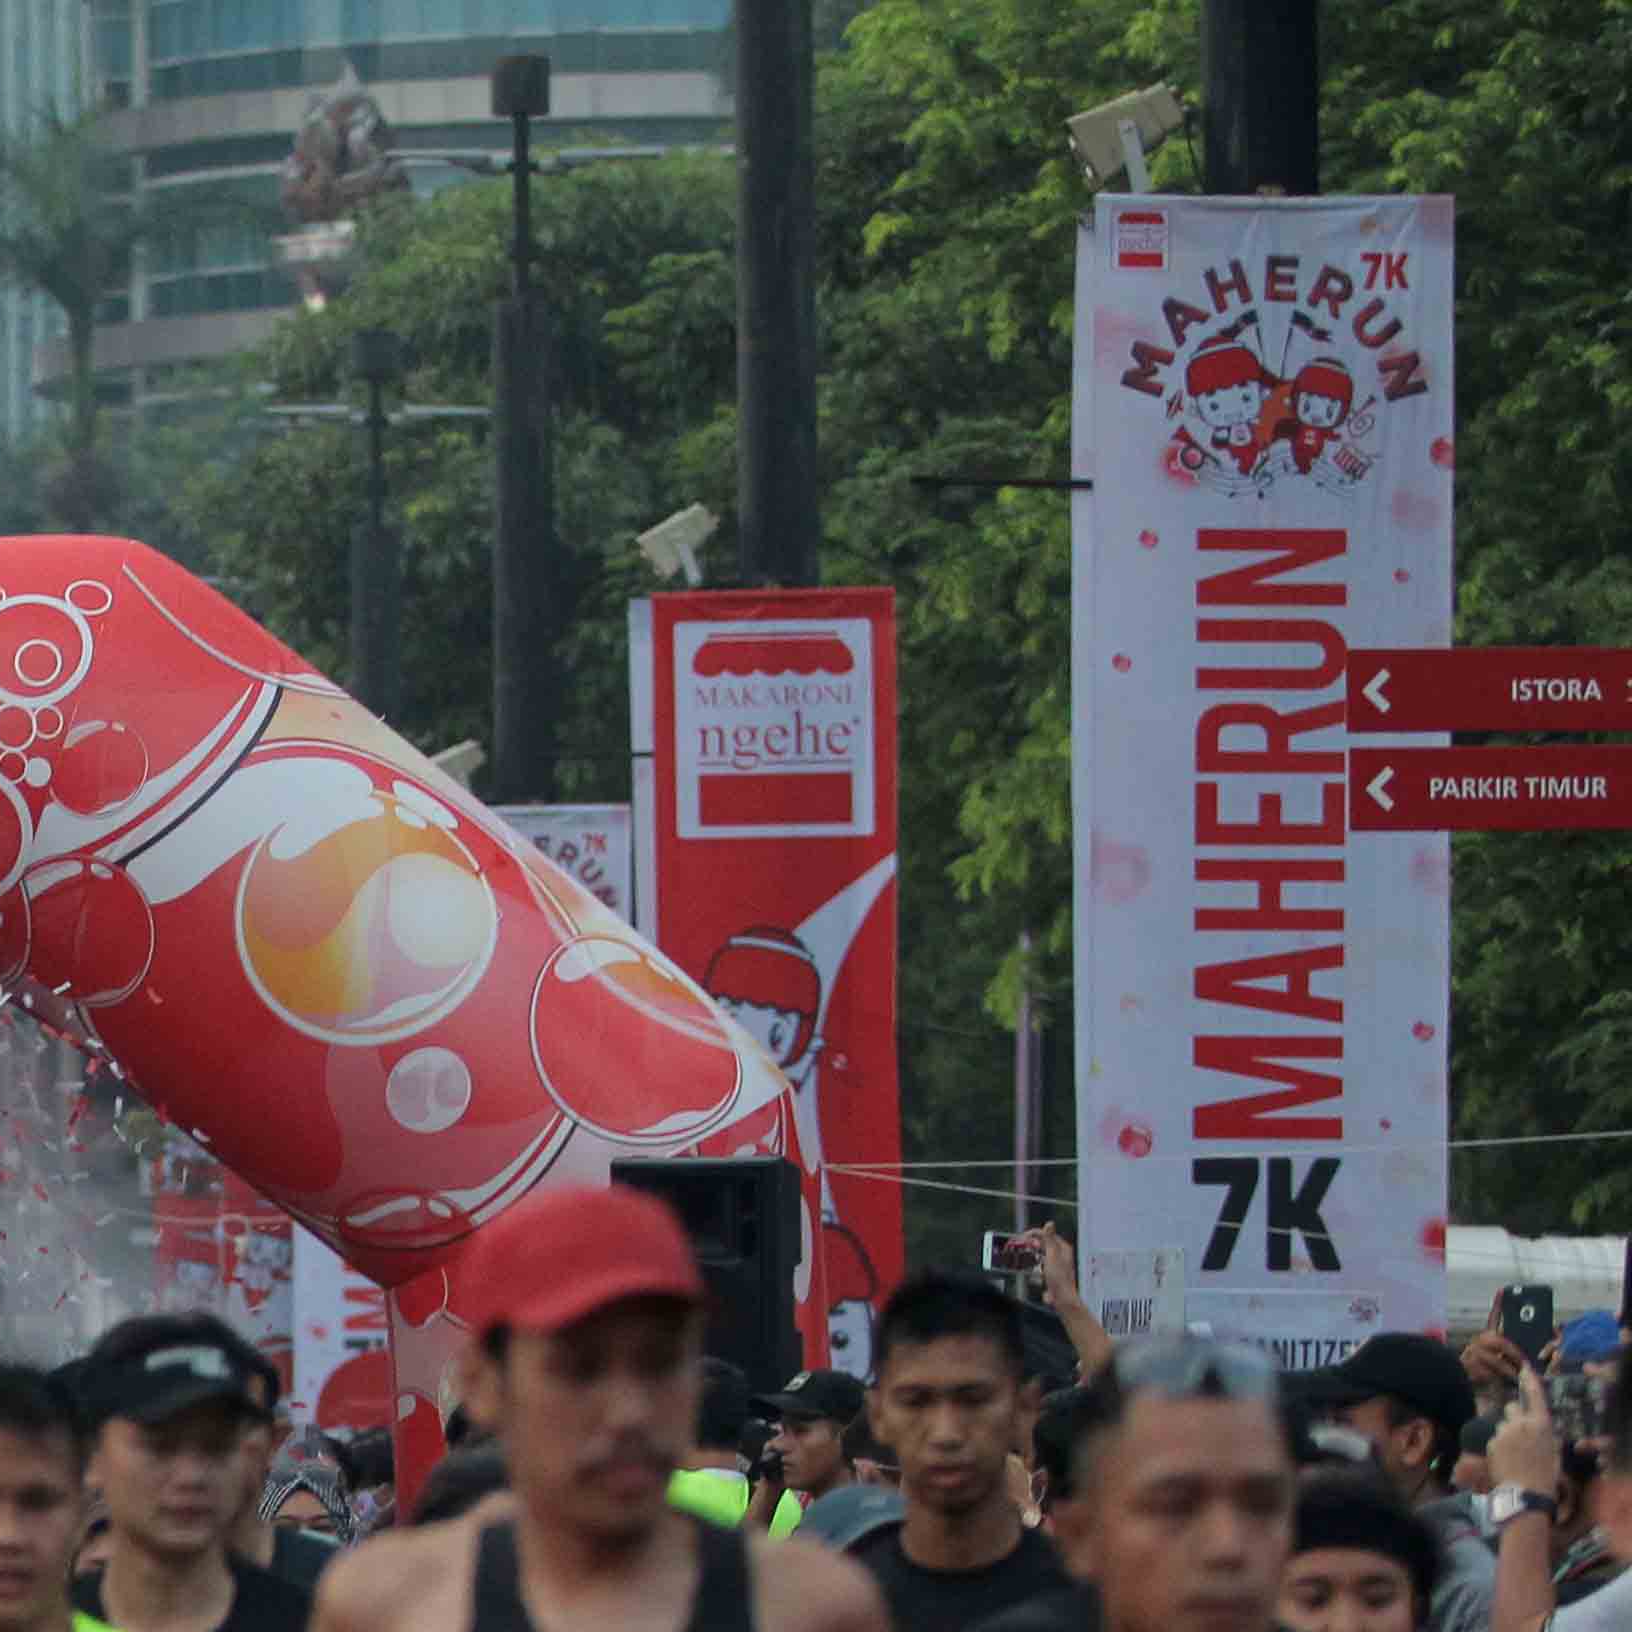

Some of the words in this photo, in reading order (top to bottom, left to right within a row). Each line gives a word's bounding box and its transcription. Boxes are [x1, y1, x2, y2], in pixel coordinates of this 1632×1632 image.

[1360, 253, 1409, 290] 7K
[1120, 255, 1428, 401] MAHERUN
[696, 685, 853, 707] MAKARONI
[1512, 677, 1602, 702] ISTORA
[698, 709, 853, 769] ngehe
[1429, 777, 1518, 799] PARKIR
[1524, 777, 1607, 799] TIMUR
[1192, 529, 1348, 1140] MAHERUN
[1192, 1158, 1342, 1272] 7K
